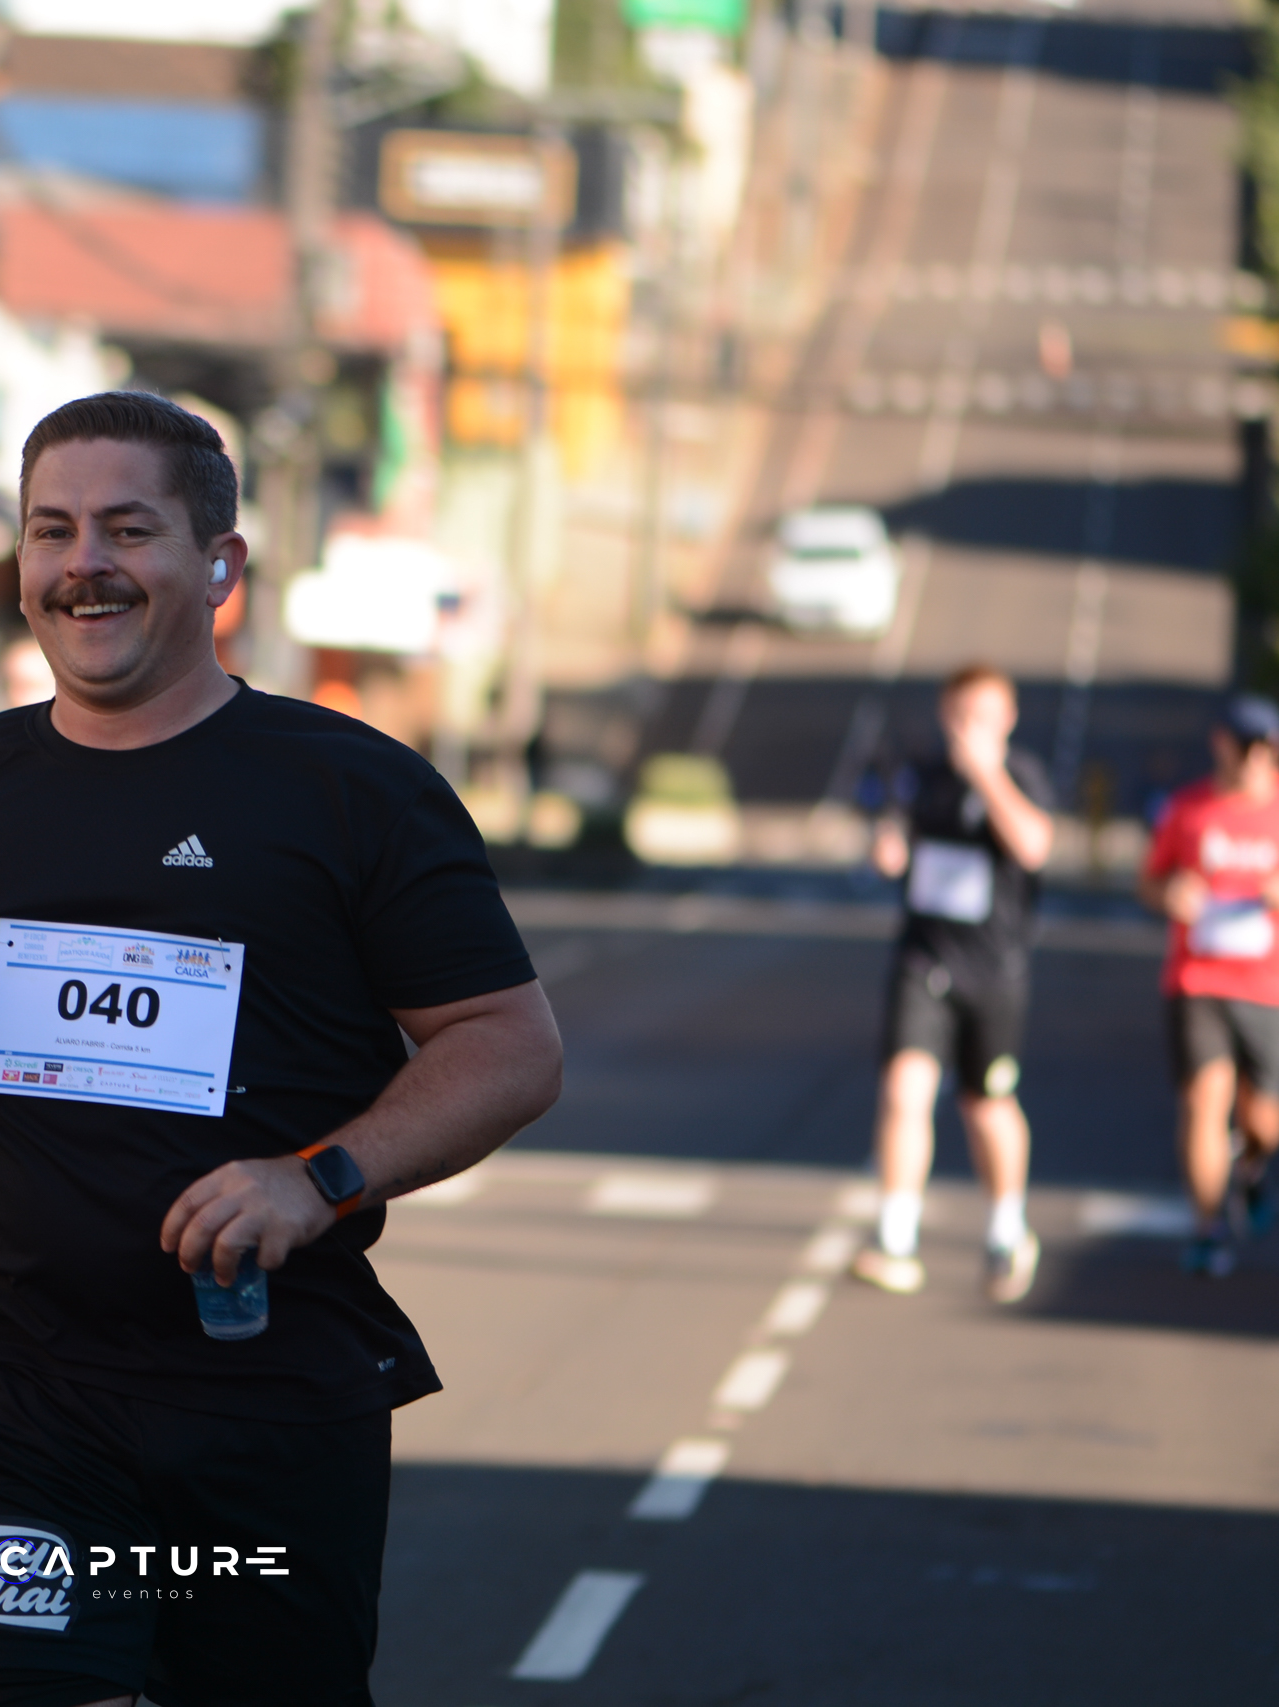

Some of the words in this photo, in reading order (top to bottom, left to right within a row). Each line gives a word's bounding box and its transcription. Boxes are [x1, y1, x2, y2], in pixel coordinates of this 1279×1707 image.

[162, 853, 214, 868] adidas
[123, 952, 140, 963] ONG
[175, 966, 209, 979] CAUSA
[57, 979, 161, 1028] 040
[81, 1040, 105, 1048] FABRIS
[110, 1043, 134, 1052] Corrida
